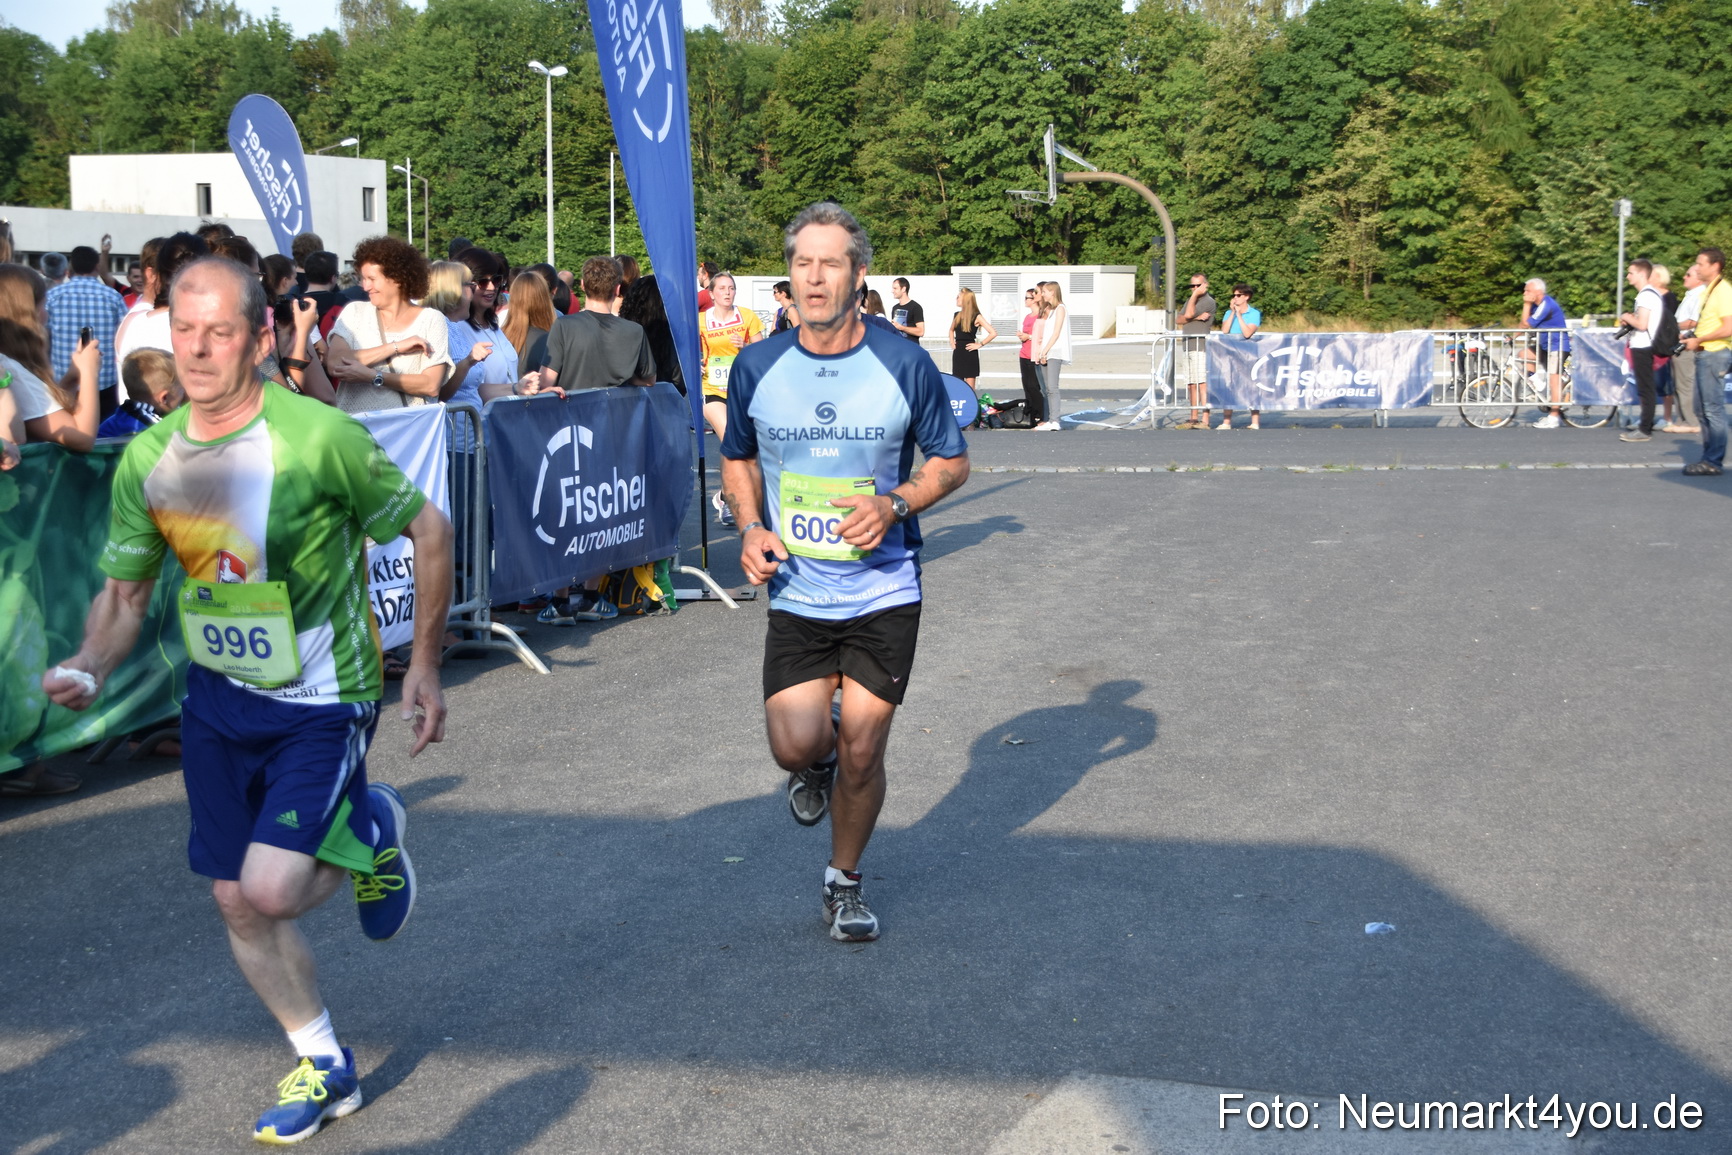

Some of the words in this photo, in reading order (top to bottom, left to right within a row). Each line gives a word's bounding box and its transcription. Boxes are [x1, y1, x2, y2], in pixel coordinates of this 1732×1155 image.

[707, 331, 725, 339] MAX
[286, 375, 301, 393] SONY
[1275, 364, 1387, 386] Fischer
[1285, 387, 1376, 398] AUTOMOBILE
[768, 427, 885, 441] SCHABMÜLLER
[810, 448, 839, 457] TEAM
[564, 518, 645, 556] AUTOMOBILE
[791, 513, 843, 545] 609
[787, 583, 900, 604] www.schabmueller.de
[203, 623, 273, 660] 996
